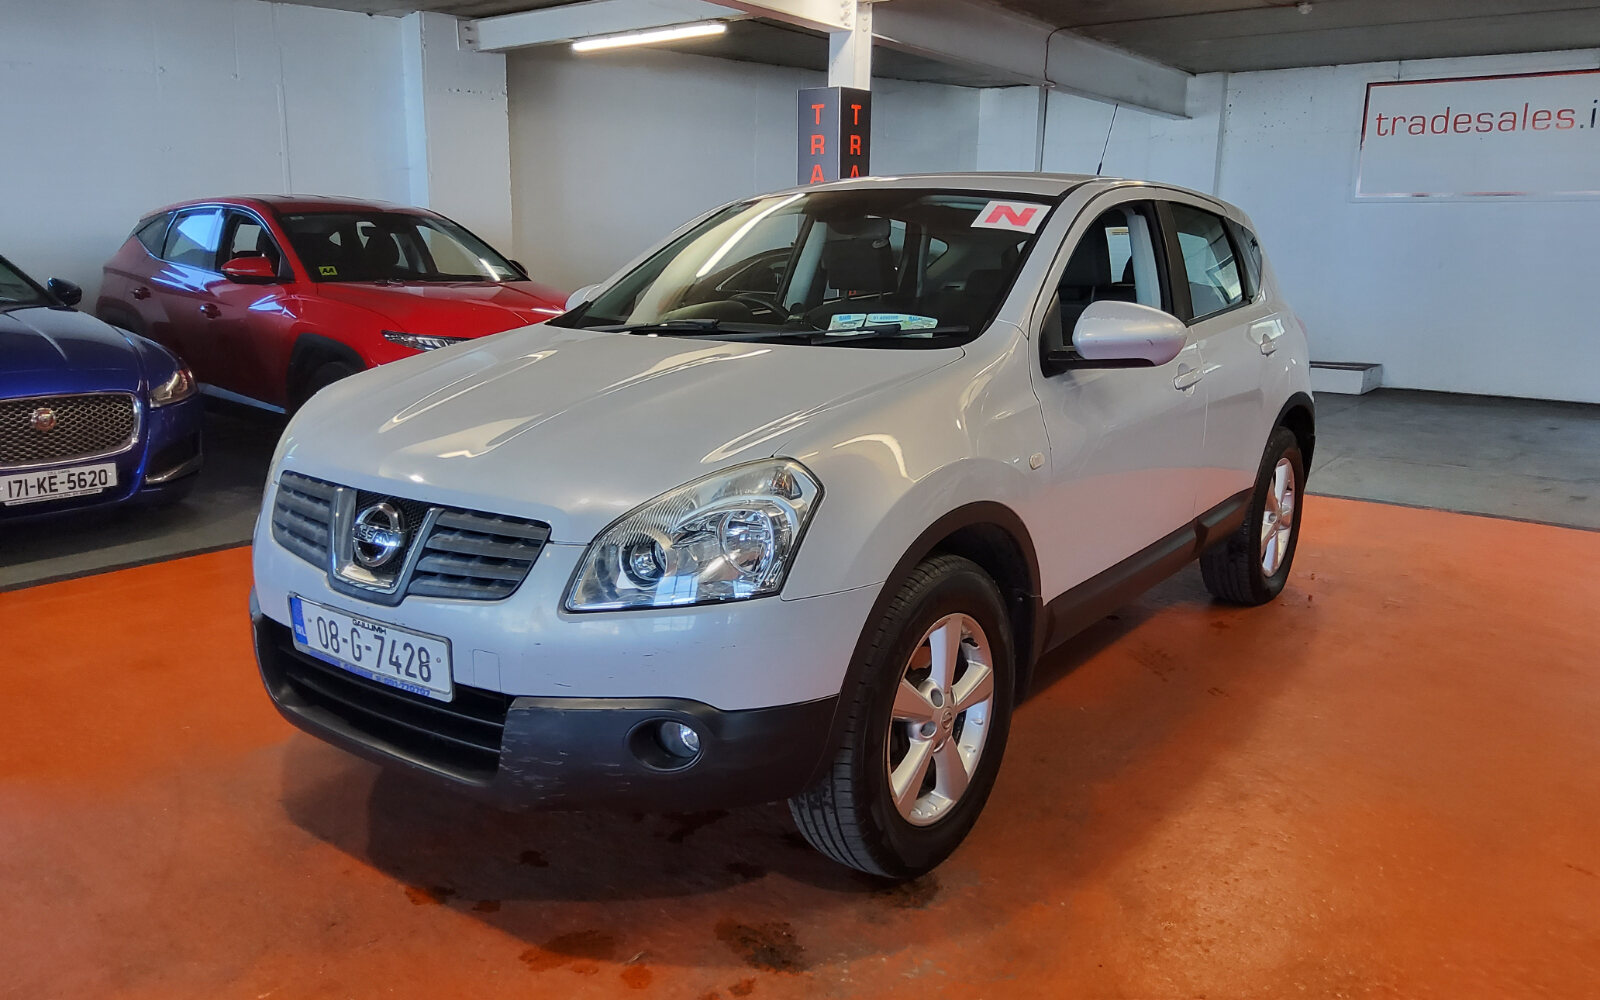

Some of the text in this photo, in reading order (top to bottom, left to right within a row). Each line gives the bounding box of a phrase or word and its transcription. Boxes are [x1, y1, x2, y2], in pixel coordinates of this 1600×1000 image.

[809, 103, 825, 185] TRA
[984, 204, 1038, 227] N
[7, 468, 108, 498] 171-KE-5620
[316, 615, 432, 683] 08-G-7428
